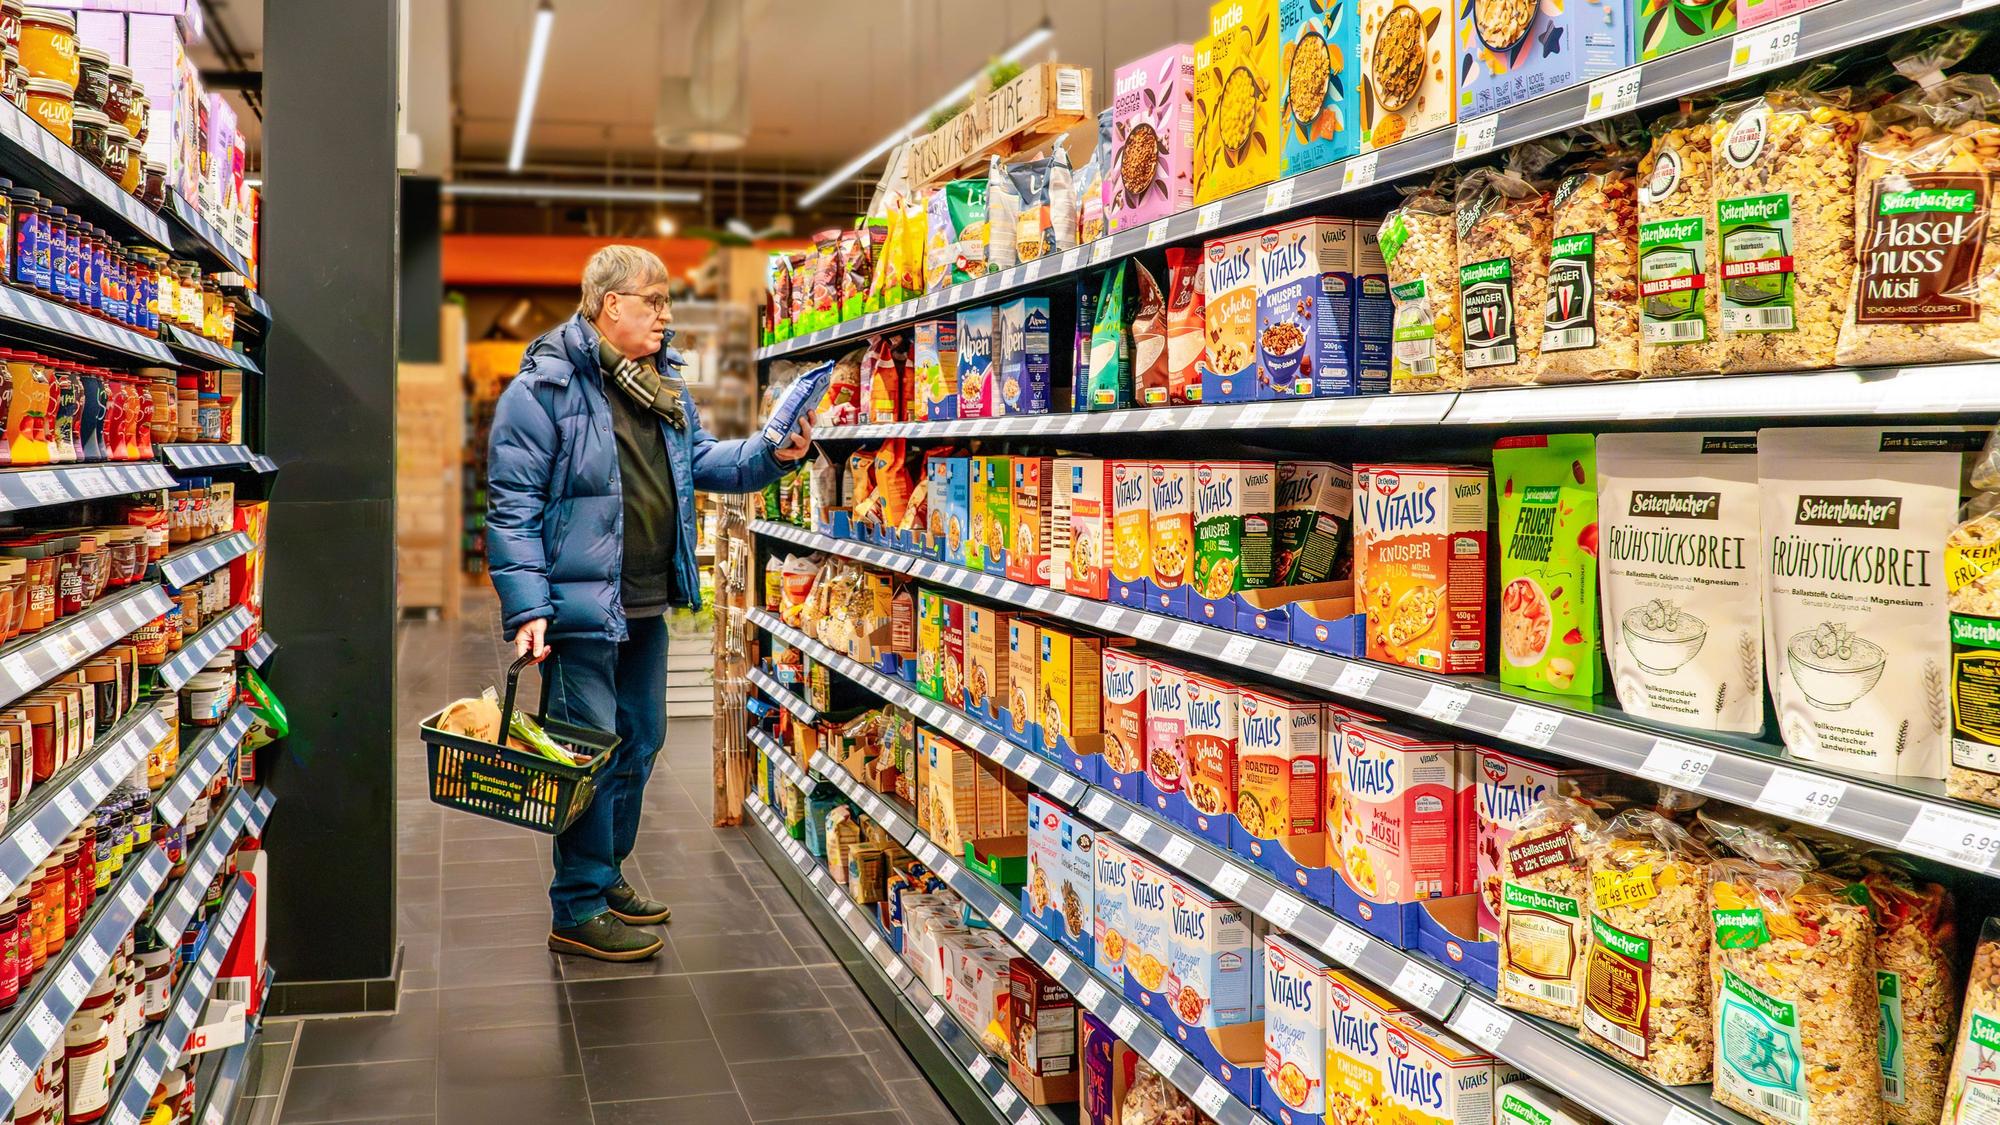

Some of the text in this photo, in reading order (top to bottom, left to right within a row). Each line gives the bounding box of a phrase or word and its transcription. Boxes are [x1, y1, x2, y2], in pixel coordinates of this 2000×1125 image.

[1213, 3, 1243, 36] turtle
[1281, 6, 1304, 32] SPELT
[1770, 31, 1799, 50] 4.99
[1117, 69, 1147, 96] turtle
[1617, 80, 1640, 98] 5.99
[1116, 91, 1140, 110] COCOA
[1479, 126, 1497, 140] 4.99
[1721, 197, 1783, 222] Seitenbacher
[1881, 192, 1971, 212] Seitenbacher
[1322, 229, 1346, 243] VITALIS
[1363, 233, 1377, 246] VITA
[1726, 259, 1781, 276] RADLER-Müsli
[1871, 250, 1945, 275] nuss
[1461, 262, 1506, 284] Seitenbacher
[1266, 284, 1302, 308] KNUSPER
[1868, 278, 1919, 299] Müsli
[1466, 292, 1502, 306] MANAGER
[1220, 294, 1251, 324] Schoko
[1029, 315, 1047, 326] Alpen
[958, 330, 991, 365] Alpen
[1245, 473, 1268, 487] VITALIS
[1455, 482, 1481, 498] VITALIS
[1375, 486, 1437, 533] VITALIS
[1632, 494, 1716, 516] Seitenbacher
[1800, 499, 1897, 525] Seitenbacher
[1515, 507, 1557, 535] FRUCHT
[1200, 522, 1230, 540] KNUSPER
[1203, 541, 1216, 552] PLUS
[1380, 542, 1431, 563] KNUSPER
[1508, 534, 1554, 562] PORRIDGE
[1609, 525, 1745, 570] FRÜHSTÜCKSBREI
[1960, 546, 2000, 560] KEIN
[1386, 564, 1408, 578] PLUS
[1772, 535, 1931, 588] FRÜHSTÜCKSBREI
[1693, 576, 1739, 587] Magnesium
[1870, 596, 1924, 607] Magnesium
[1651, 702, 1700, 715] Landwirtschaft
[1658, 694, 1691, 705] deutscher
[1292, 713, 1316, 728] VITALIS
[1534, 722, 1556, 736] 6.99
[1821, 741, 1878, 757] Landwirtschaft
[1830, 733, 1867, 747] deutscher
[1197, 738, 1223, 762] Schoko
[1245, 759, 1279, 776] ROASTED
[1347, 755, 1395, 796] VITALIS
[1681, 758, 1708, 776] 6.99
[472, 771, 523, 790] Eigentum der
[1246, 773, 1263, 785] MÜSLI
[1806, 790, 1839, 809] 4.99
[1373, 808, 1400, 828] Joghurt
[1371, 819, 1400, 846] MÜSLI
[1522, 835, 1567, 858] Ballaststoffe
[1961, 832, 2000, 854] 6.99
[1524, 859, 1539, 872] 22%
[1539, 850, 1565, 867] Eiweiß
[1506, 886, 1572, 912] Seitenbacher
[1623, 882, 1647, 900] Fett
[1595, 952, 1633, 980] Confiserie
[1485, 1022, 1506, 1040] 6.99
[1337, 1056, 1374, 1085] KNUSPER
[1388, 1057, 1443, 1109] VITALIS
[1458, 1072, 1488, 1091] VITALIS
